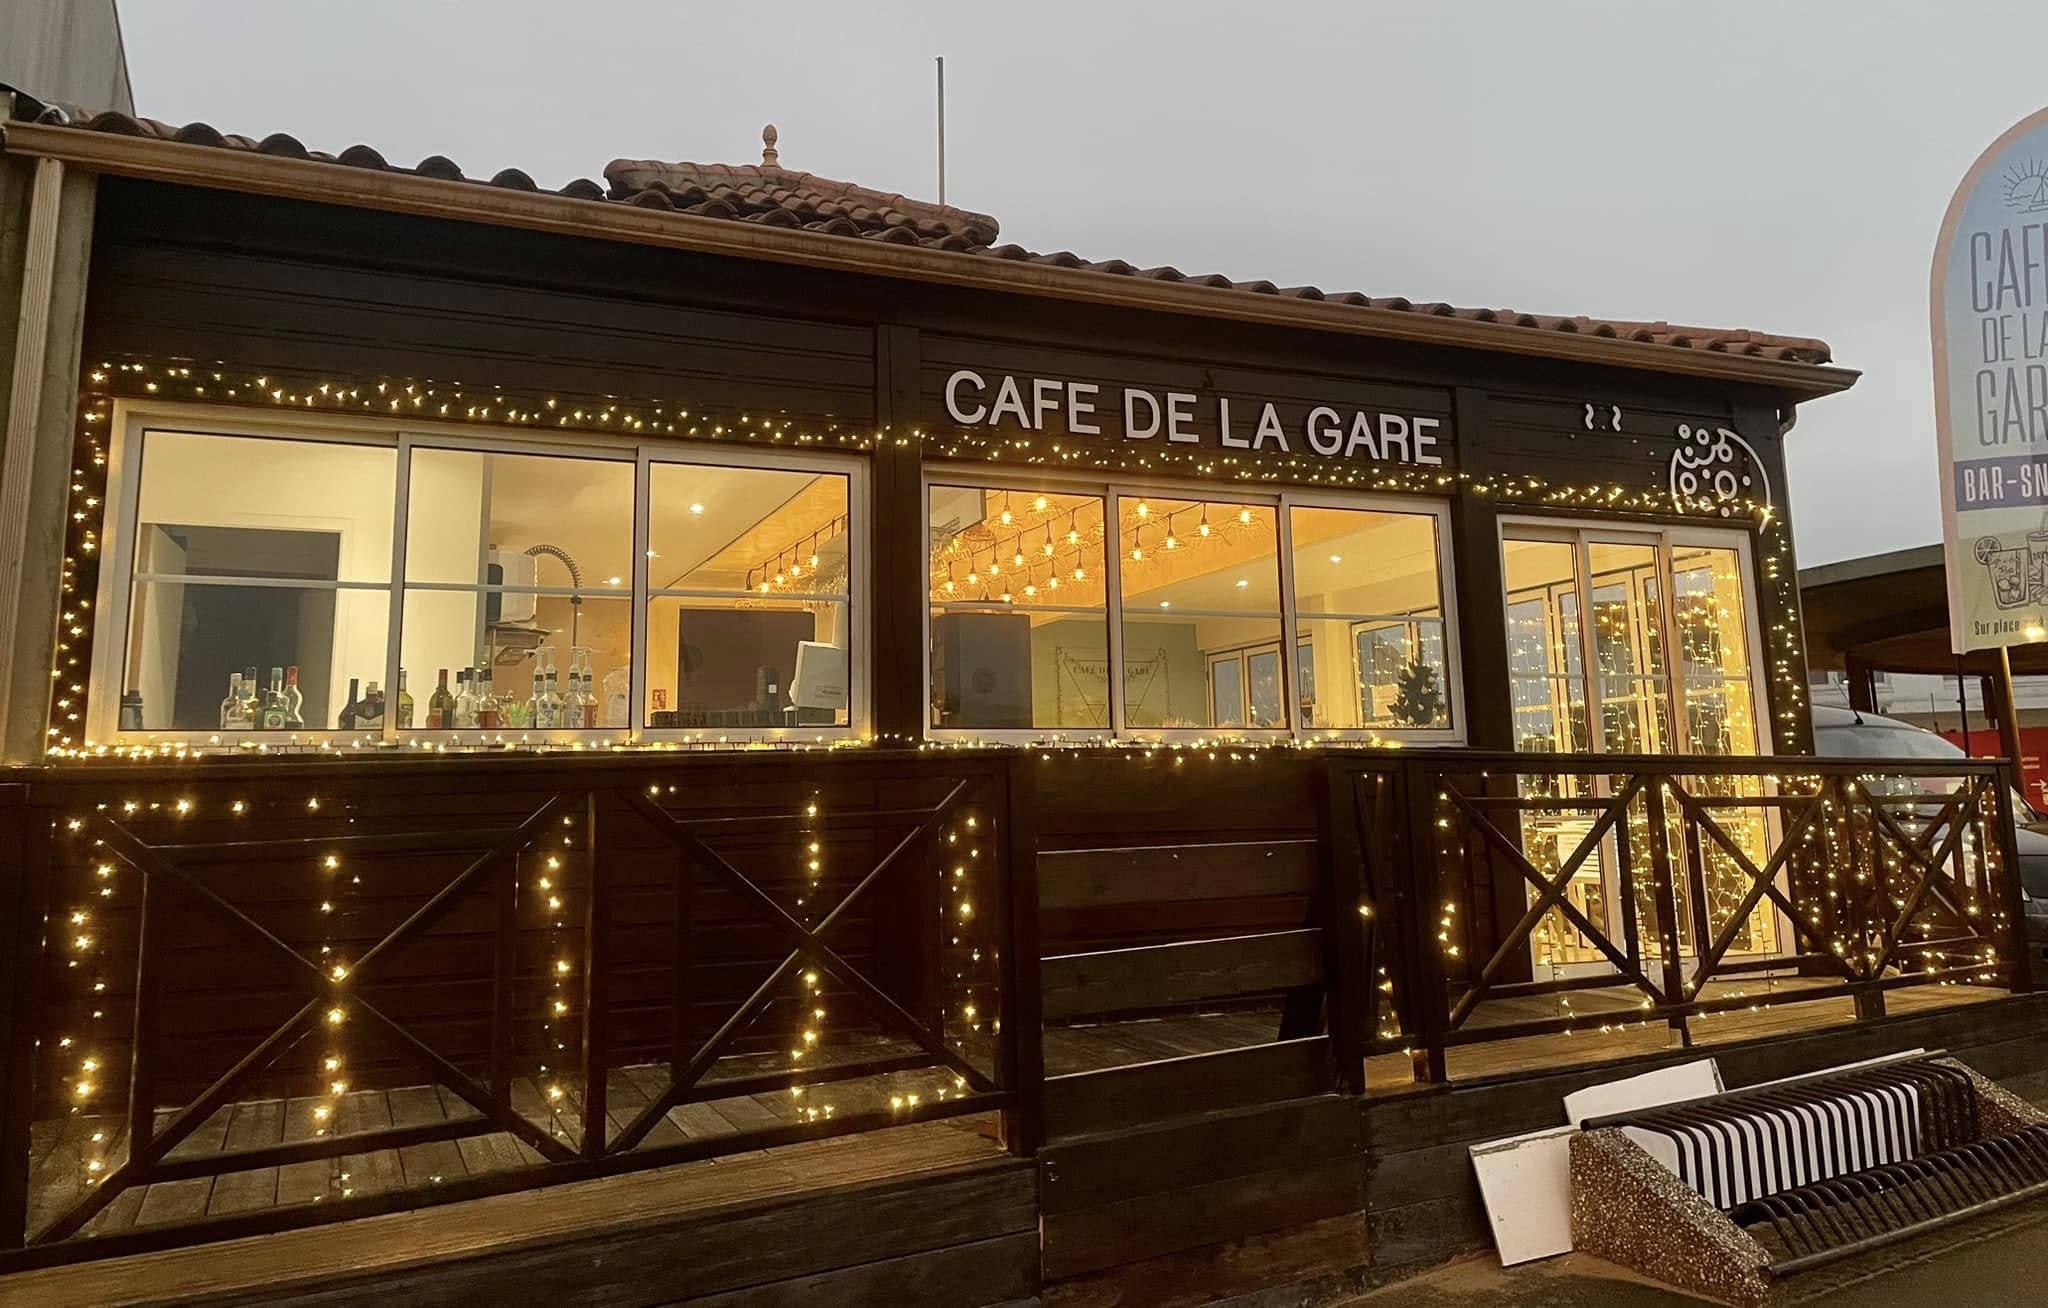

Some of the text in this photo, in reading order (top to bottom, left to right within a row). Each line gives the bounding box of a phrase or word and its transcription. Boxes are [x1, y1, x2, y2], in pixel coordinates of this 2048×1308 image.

[1982, 314, 2015, 364] DE
[945, 370, 1443, 465] CAFE DE LA GARE
[1974, 620, 1991, 636] Sur
